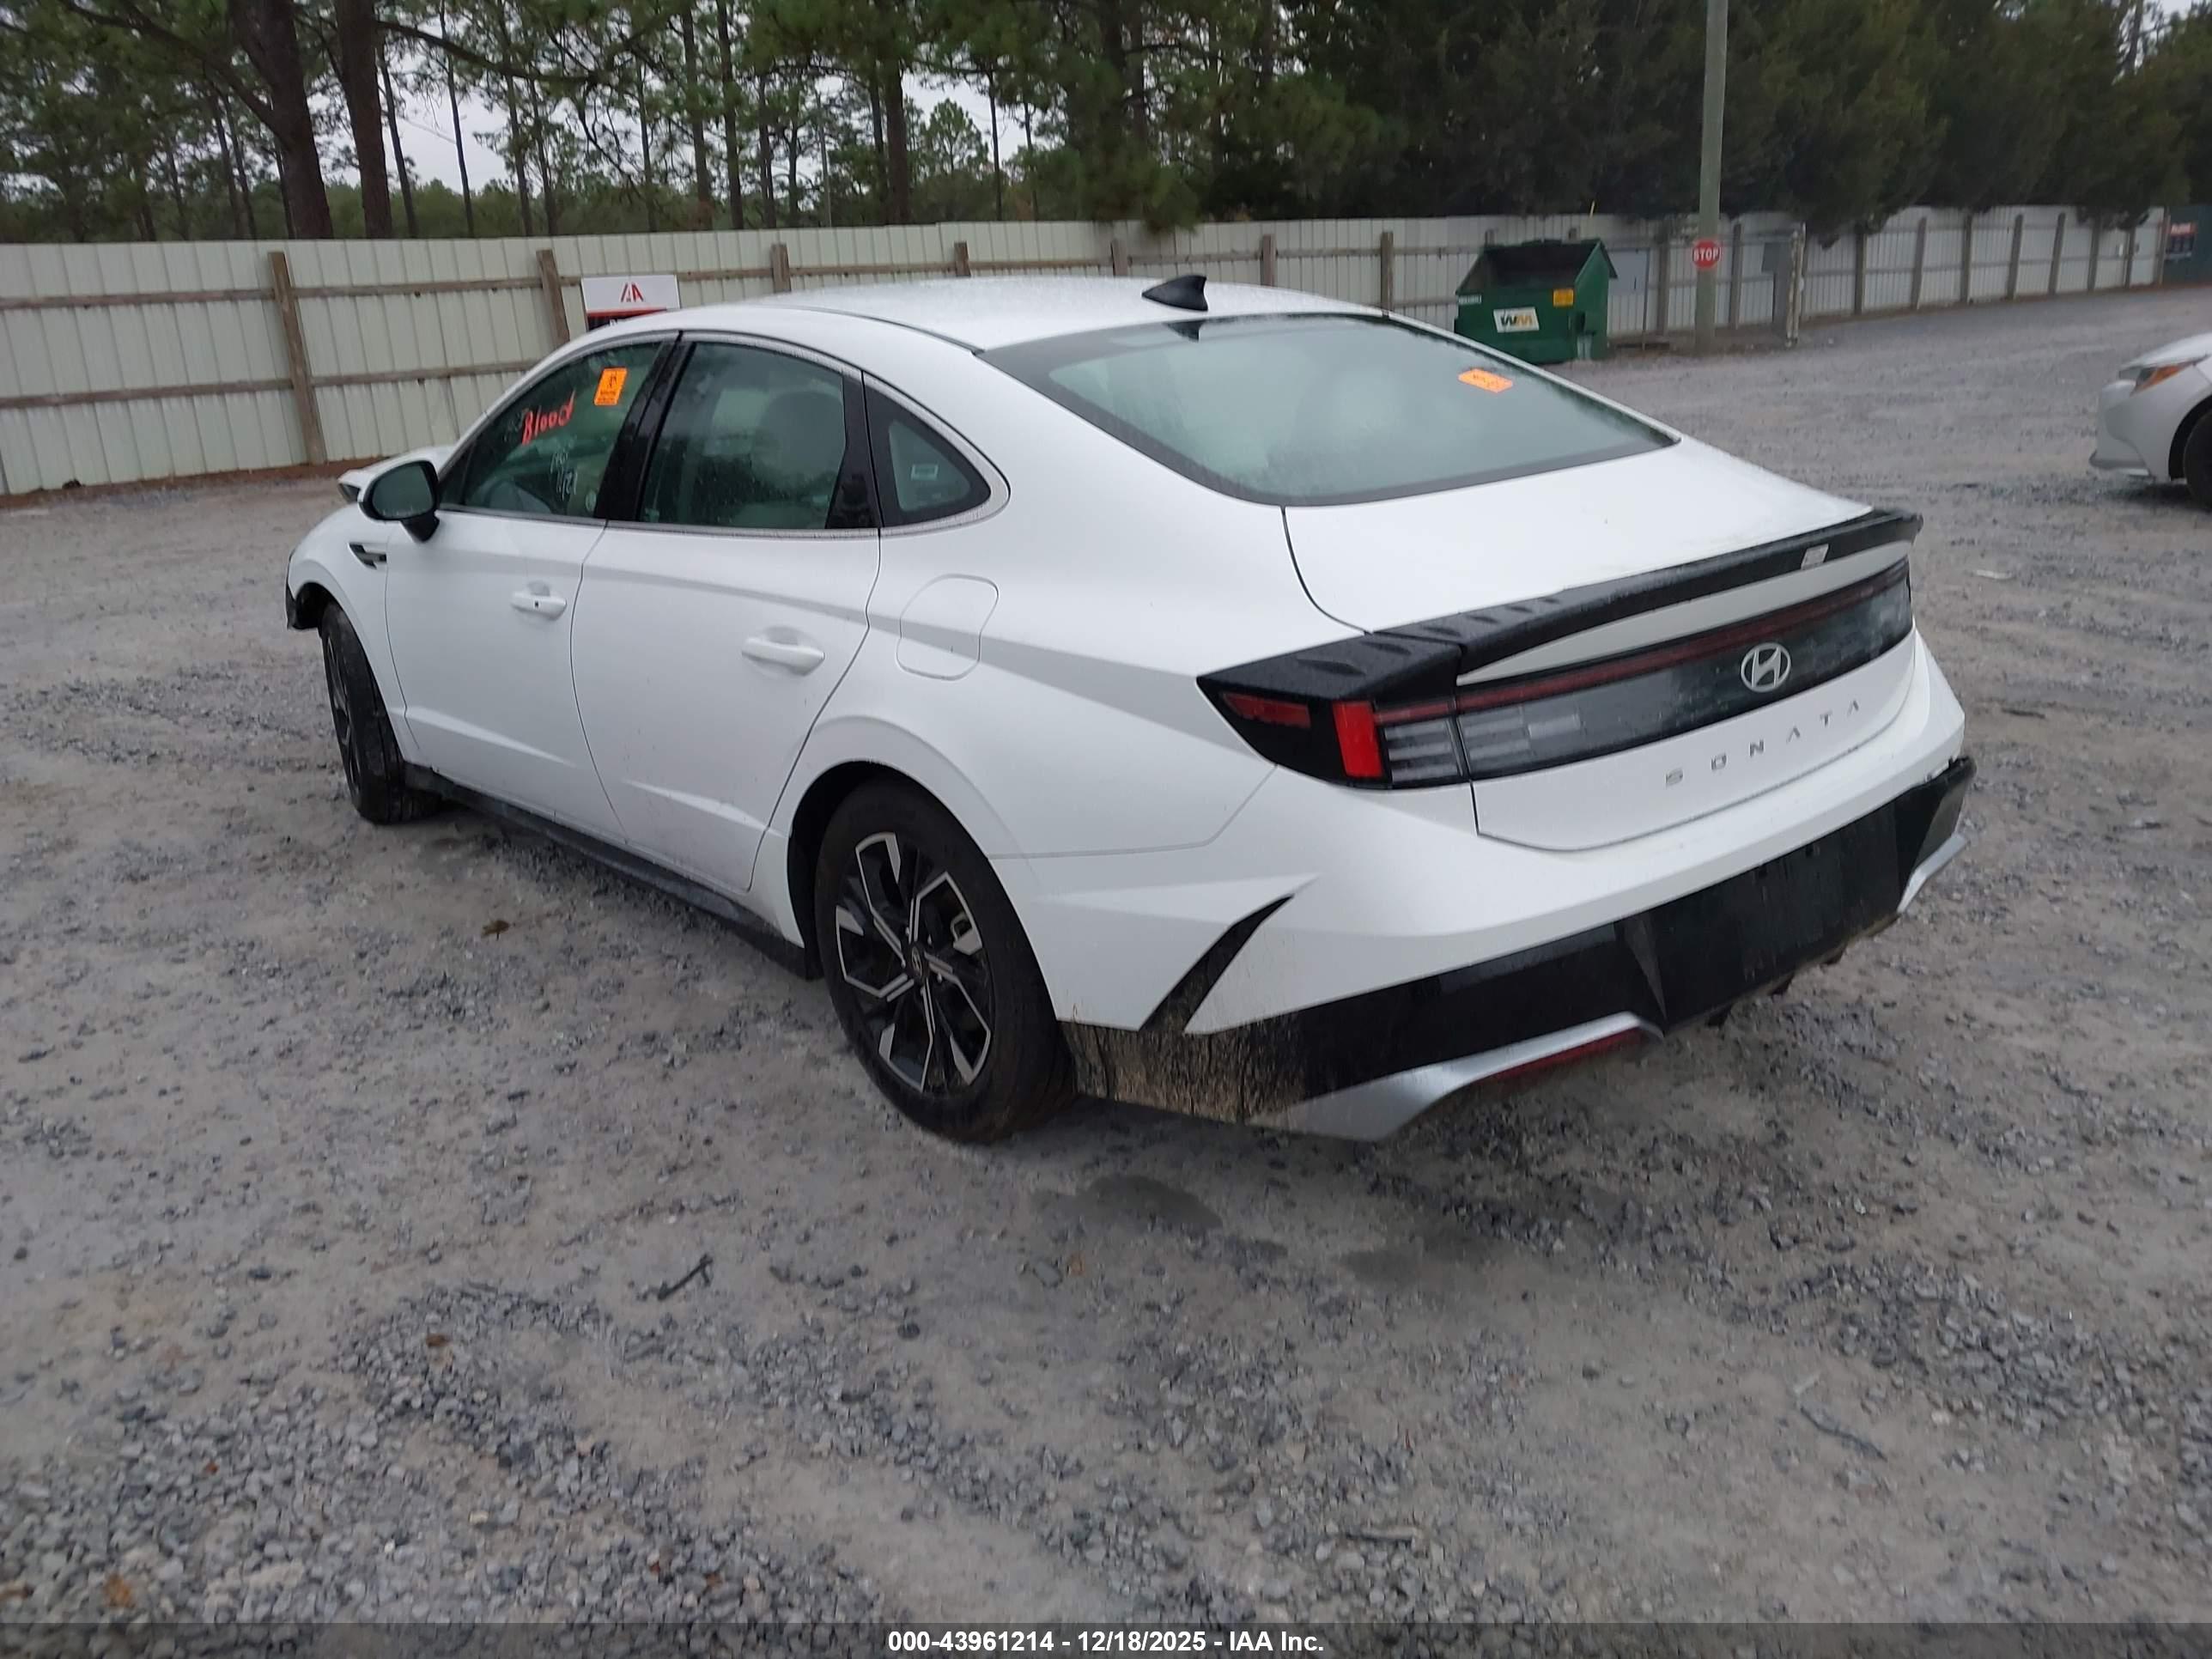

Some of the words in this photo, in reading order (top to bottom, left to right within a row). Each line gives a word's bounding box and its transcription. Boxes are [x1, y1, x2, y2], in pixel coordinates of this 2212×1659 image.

[1693, 246, 1720, 262] STOP
[1500, 315, 1534, 326] WM
[521, 388, 576, 446] Blood
[1664, 699, 1860, 787] SONATA
